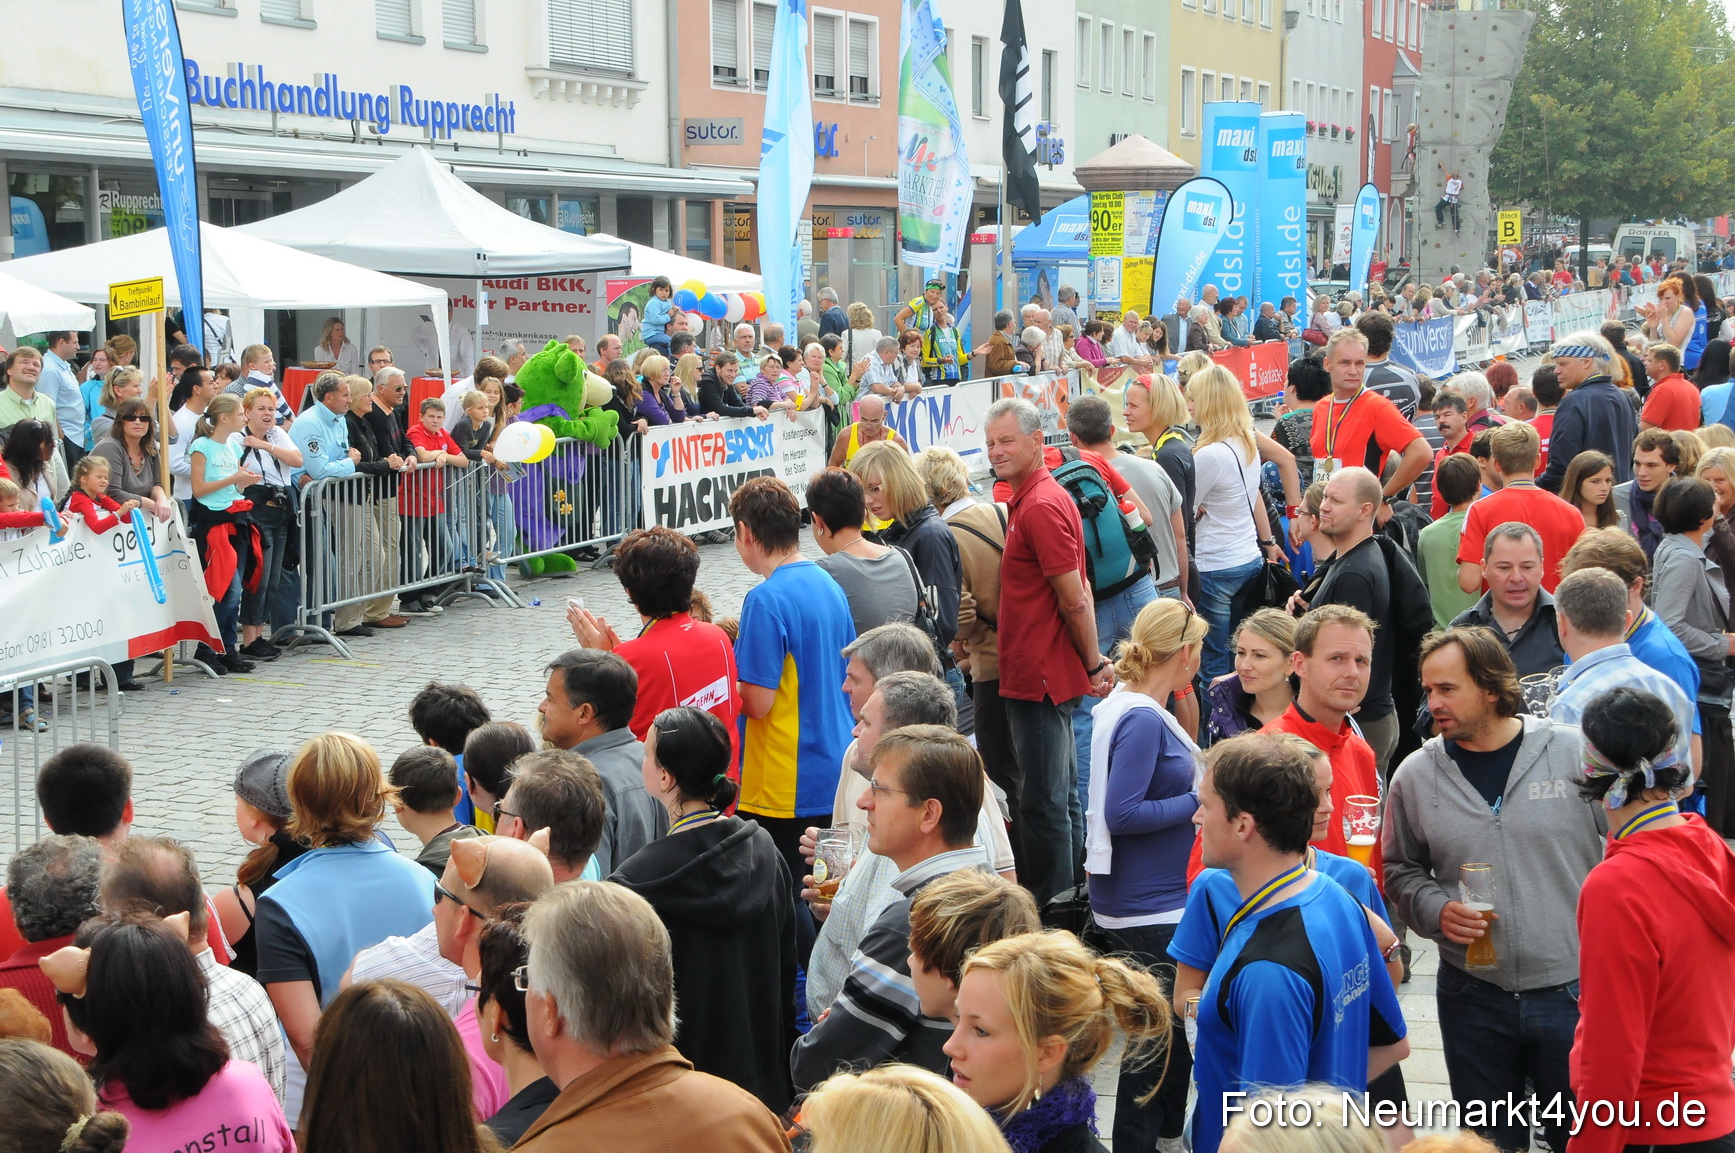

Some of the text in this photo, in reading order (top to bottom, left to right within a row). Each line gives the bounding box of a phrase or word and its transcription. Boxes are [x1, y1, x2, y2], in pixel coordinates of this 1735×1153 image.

[184, 58, 390, 134] Buchhandlung
[399, 84, 515, 140] Rupprecht
[686, 123, 738, 140] sutor.
[814, 121, 839, 157] or.
[1217, 127, 1256, 147] maxi
[1243, 147, 1257, 162] dsl
[1272, 137, 1304, 157] maxi
[1187, 200, 1215, 216] maxi
[847, 214, 882, 226] sutor.
[1057, 222, 1088, 233] maxi
[1203, 215, 1215, 227] dsl
[1504, 221, 1515, 237] B
[128, 286, 153, 296] Treffpunkt
[537, 278, 592, 294] BKK,
[120, 294, 161, 311] Bambinilauf
[504, 297, 591, 314] Partner.
[783, 428, 818, 441] Kastengasse
[671, 424, 775, 475] INTERSPORT
[783, 449, 807, 462] Im Herzen
[785, 461, 807, 476] der Stadt
[12, 541, 92, 575] Zuhause.
[0, 640, 24, 661] efon:
[57, 618, 103, 645] 3200-0
[1528, 780, 1567, 800] BZR
[174, 1117, 265, 1153] nstall
